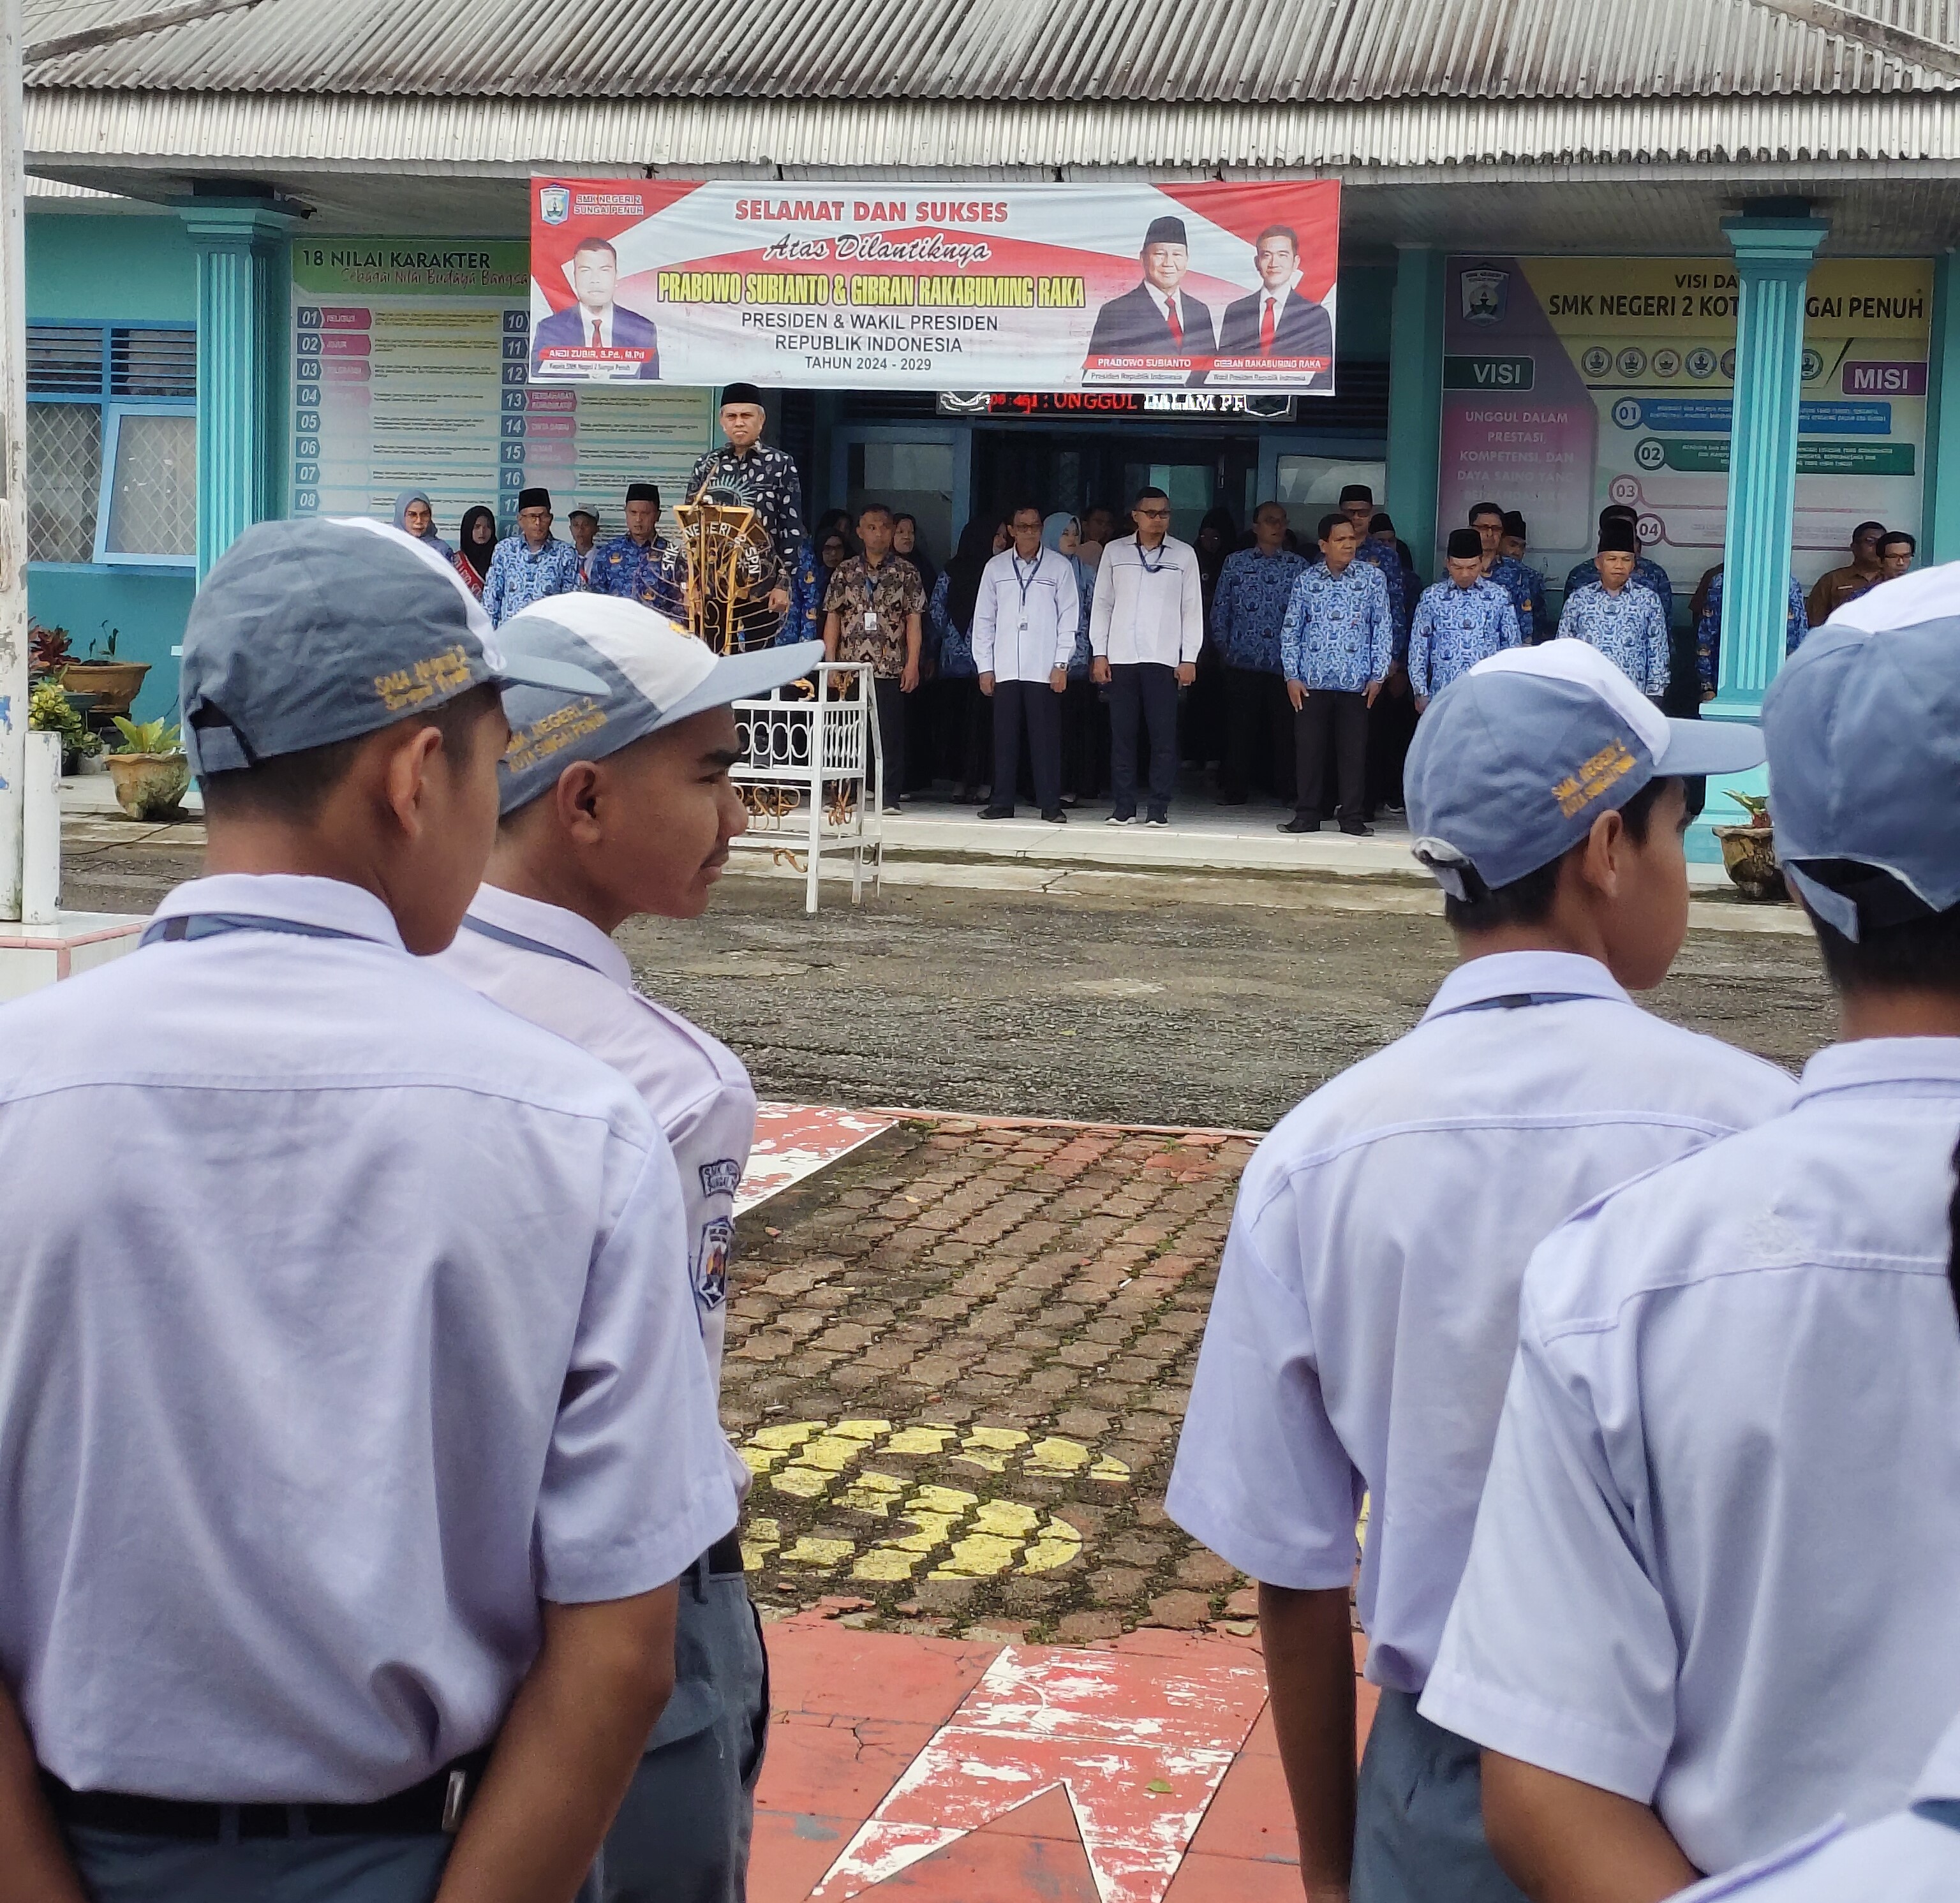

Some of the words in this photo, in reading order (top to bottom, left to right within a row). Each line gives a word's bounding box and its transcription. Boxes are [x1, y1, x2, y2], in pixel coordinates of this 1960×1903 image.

[574, 206, 609, 214] SUNGAI
[611, 206, 643, 215] PENUH
[736, 200, 845, 221] SELAMAT
[854, 202, 906, 221] DAN
[916, 202, 1009, 222] SUKSES
[765, 233, 828, 258] Atas
[836, 233, 991, 267] Dilantiknya
[303, 250, 324, 267] 18
[331, 251, 383, 268] NILAI
[390, 251, 491, 269] KARAKTER
[341, 268, 390, 284] Sebagai
[395, 269, 422, 285] Nilai
[427, 268, 476, 290] Budaya
[482, 270, 529, 289] Bangsa
[1674, 274, 1707, 288] VISI
[1714, 275, 1739, 289] DA
[658, 272, 742, 303] PRABOWO
[745, 273, 829, 305] SUBIANTO
[833, 274, 848, 306] &
[850, 274, 915, 306] GIBRAN
[918, 276, 1034, 307] RAKABUMING
[1037, 276, 1086, 307] RAKA
[1548, 295, 1594, 316] SMK
[1600, 295, 1675, 317] NEGERI
[1681, 297, 1693, 317] 2
[1700, 296, 1739, 318] KOT
[1806, 297, 1842, 318] GAI
[1848, 297, 1924, 319] PENUH
[302, 311, 318, 325] 01
[508, 314, 523, 329] 10
[742, 313, 828, 328] PRESIDEN
[833, 314, 845, 329] &
[850, 315, 906, 329] WAKIL
[910, 315, 998, 330] PRESIDEN
[302, 337, 318, 351] 02
[507, 341, 522, 355] 11
[775, 335, 861, 350] REPUBLIK
[868, 337, 963, 352] INDONESIA
[301, 362, 318, 376] 03
[805, 357, 851, 369] TAHUN
[857, 357, 887, 369] 2024
[900, 359, 932, 371] 2029
[1146, 359, 1191, 367] SUBIANTO
[507, 366, 523, 381] 12
[1473, 364, 1521, 384] VISI
[1853, 368, 1909, 390] MISI
[301, 389, 318, 402] 04
[507, 392, 523, 407] 13
[1053, 393, 1138, 410] UNGGUL
[1466, 411, 1518, 424] UNGGUL
[1523, 412, 1568, 424] DALAM
[1619, 406, 1638, 421] 01
[301, 415, 317, 429] 05
[506, 418, 522, 434] 14
[301, 441, 317, 454] 06
[505, 445, 521, 459] 15
[1642, 447, 1661, 461] 02
[1545, 452, 1574, 463] DAN
[299, 466, 316, 480] 07
[505, 471, 521, 486] 16
[1457, 470, 1490, 481] DAYA
[1616, 485, 1636, 498] 03
[299, 492, 315, 507] 08
[504, 498, 519, 513] 17
[505, 524, 519, 538] 18
[1639, 523, 1659, 537] 04
[662, 543, 679, 571] SMK
[685, 522, 731, 539] NEERI
